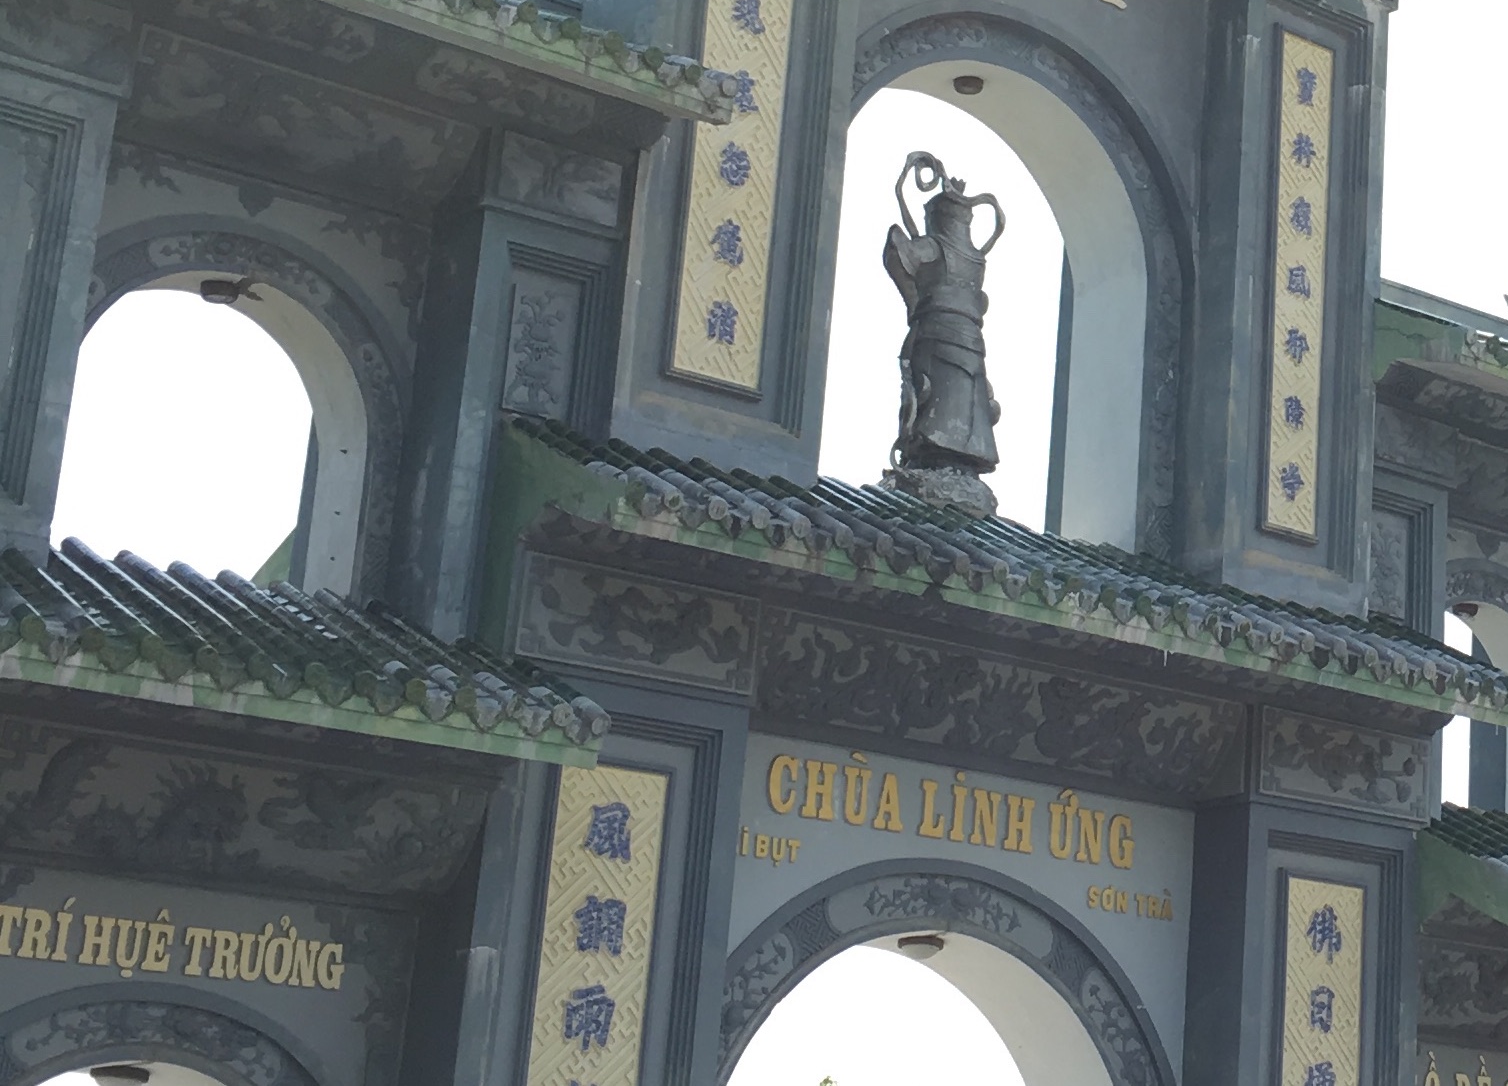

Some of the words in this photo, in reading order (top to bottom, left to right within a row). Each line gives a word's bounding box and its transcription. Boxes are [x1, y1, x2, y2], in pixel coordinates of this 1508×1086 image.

[769, 751, 903, 833] CHÙA
[1048, 788, 1136, 870] ỨNG
[754, 833, 801, 867] BỤT
[1087, 884, 1128, 914] SƠN
[1134, 888, 1173, 922] TRÀ
[0, 897, 76, 962] TRÍ
[184, 915, 346, 990] TRƯỞNG
